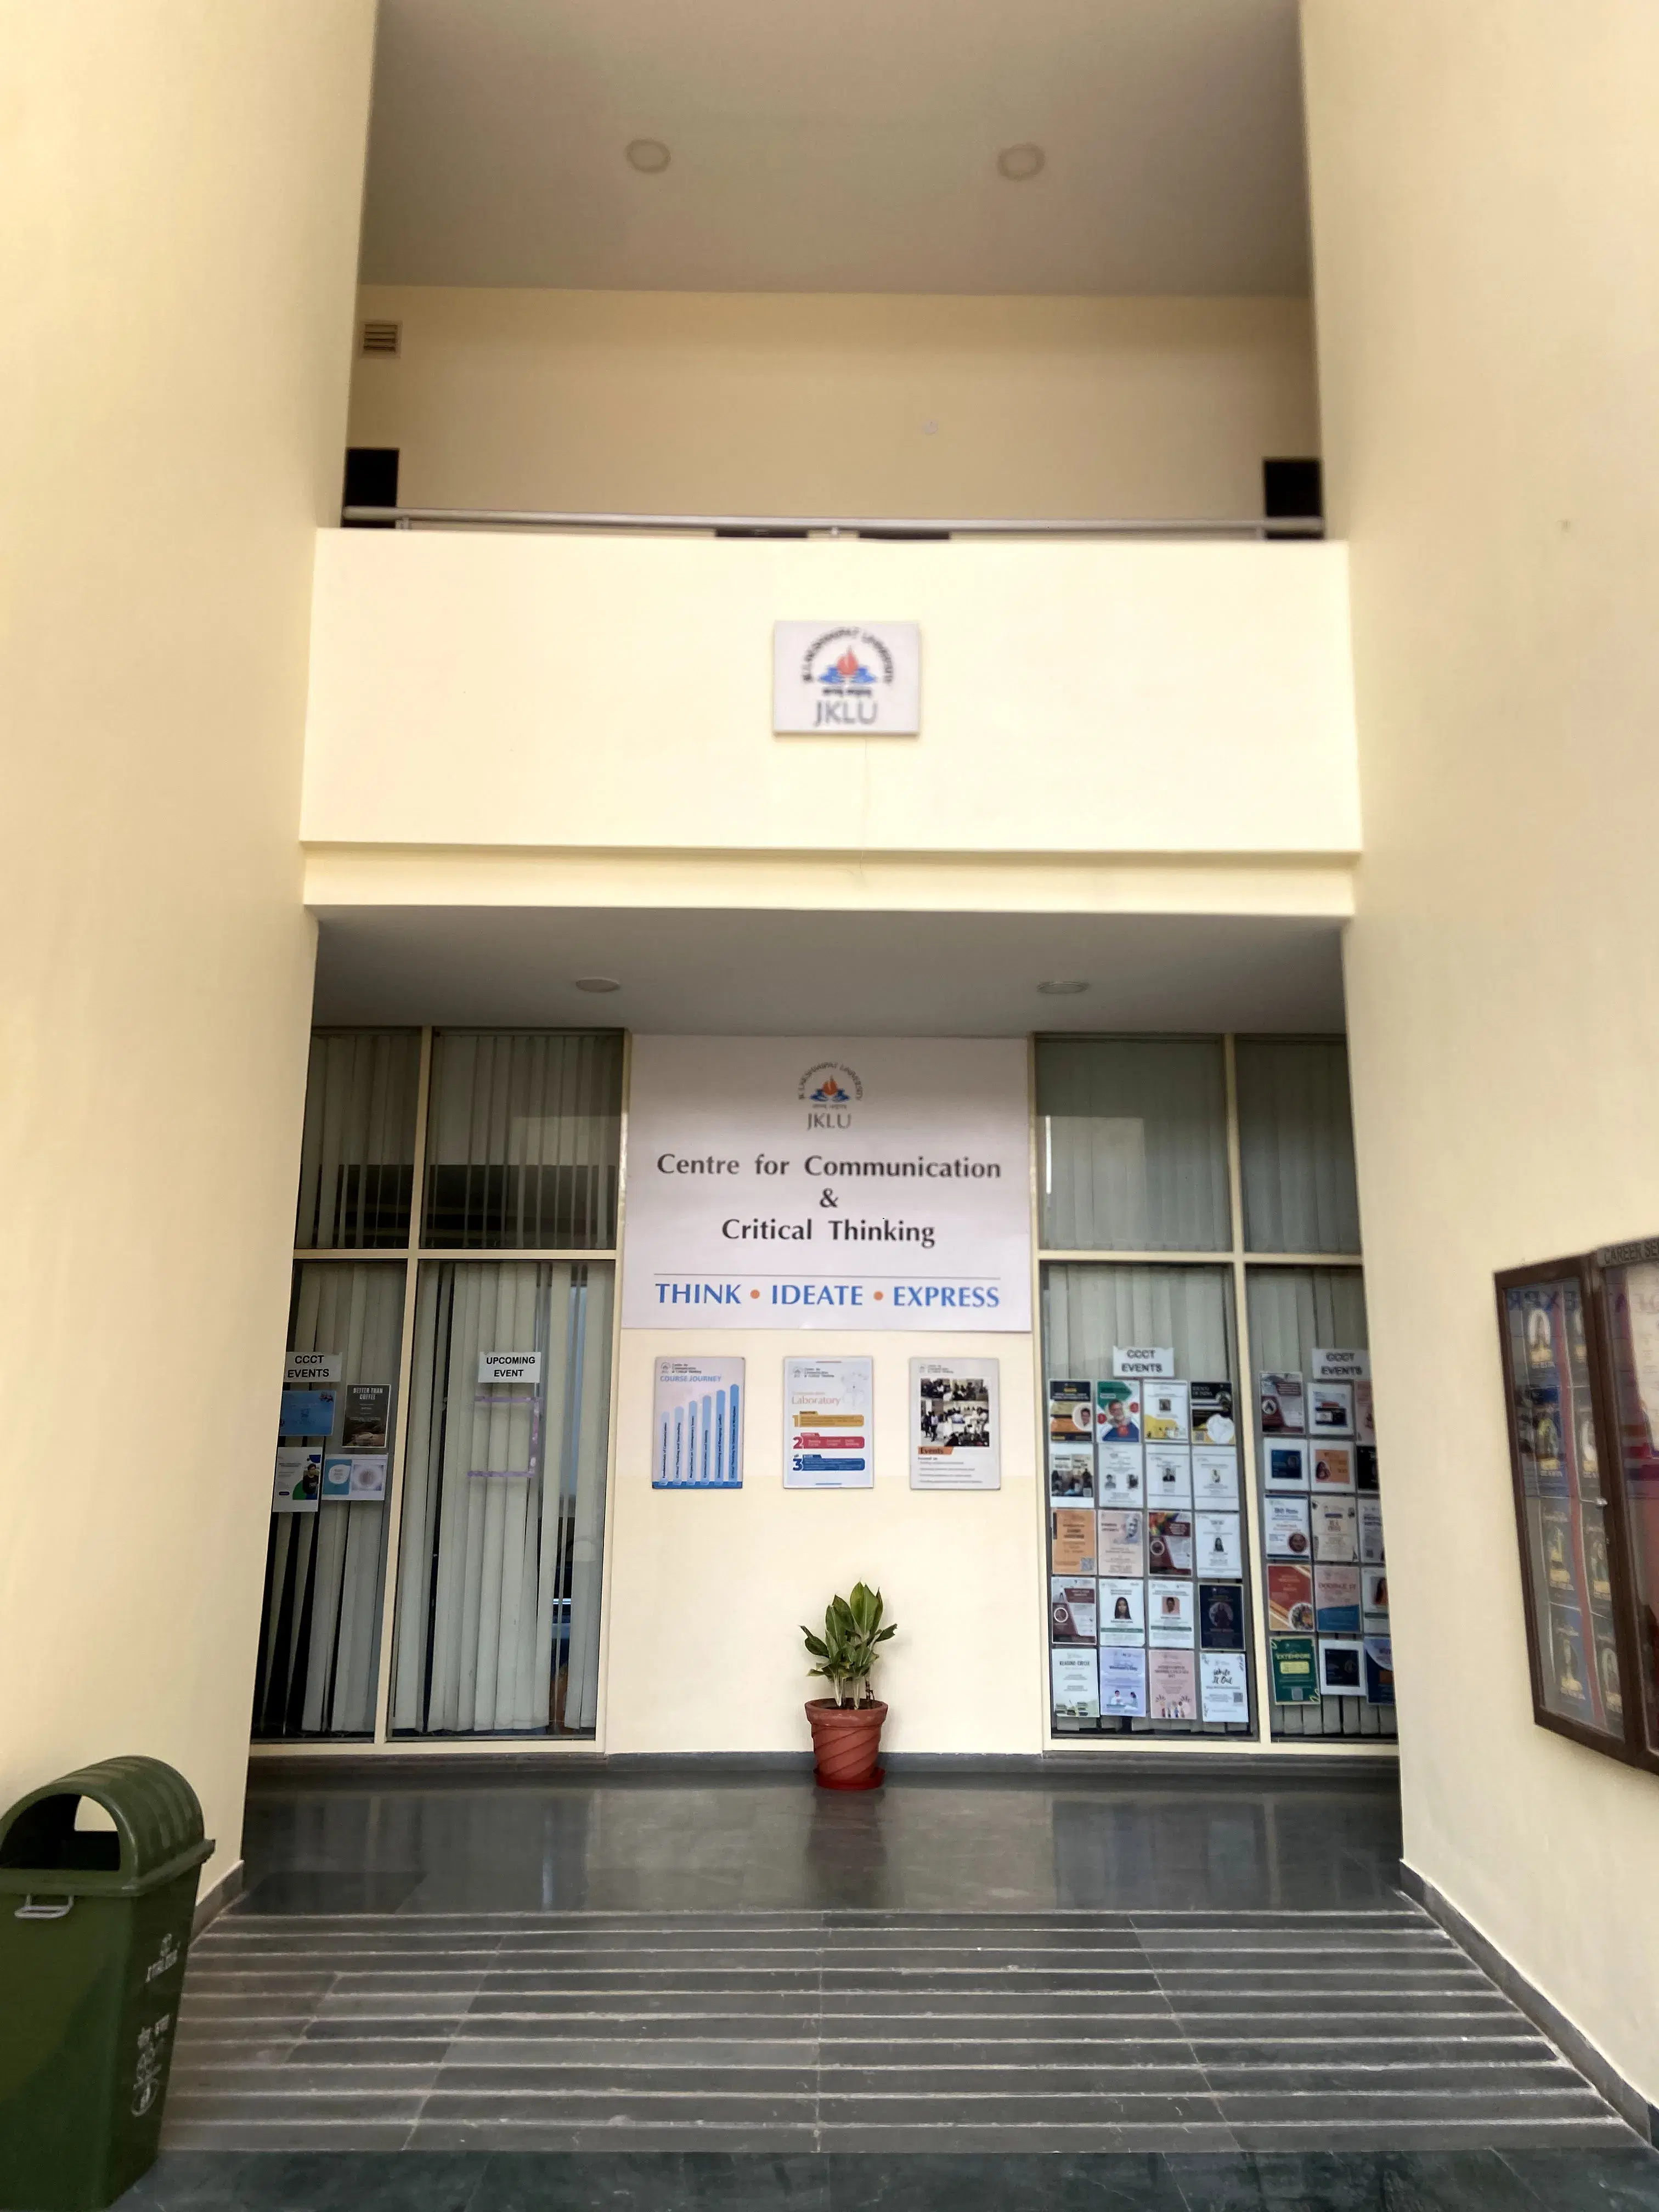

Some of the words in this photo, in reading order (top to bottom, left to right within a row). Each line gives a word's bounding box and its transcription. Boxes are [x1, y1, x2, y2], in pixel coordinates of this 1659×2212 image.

[814, 699, 878, 727] JKLU
[807, 1113, 851, 1130] JKLU
[657, 1153, 740, 1175] Centre
[755, 1153, 790, 1175] for
[804, 1155, 1001, 1178] Communication
[819, 1188, 839, 1208] &
[722, 1218, 812, 1240] Critical
[828, 1220, 936, 1249] Thinking
[1604, 1242, 1644, 1265] CAREER
[655, 1283, 742, 1305] THINK
[771, 1285, 864, 1306] IDEATE
[893, 1286, 1001, 1308] EXPRESS
[295, 1355, 324, 1364] CCCT
[486, 1356, 535, 1364] UPCOMING
[1127, 1350, 1155, 1359] CCCT
[287, 1369, 329, 1378] EVENTS
[1121, 1363, 1163, 1373] EVENTS
[1321, 1366, 1363, 1375] EVENTS
[792, 1395, 840, 1407] Laboratory
[793, 1436, 803, 1449] 2
[793, 1458, 803, 1471] 3
